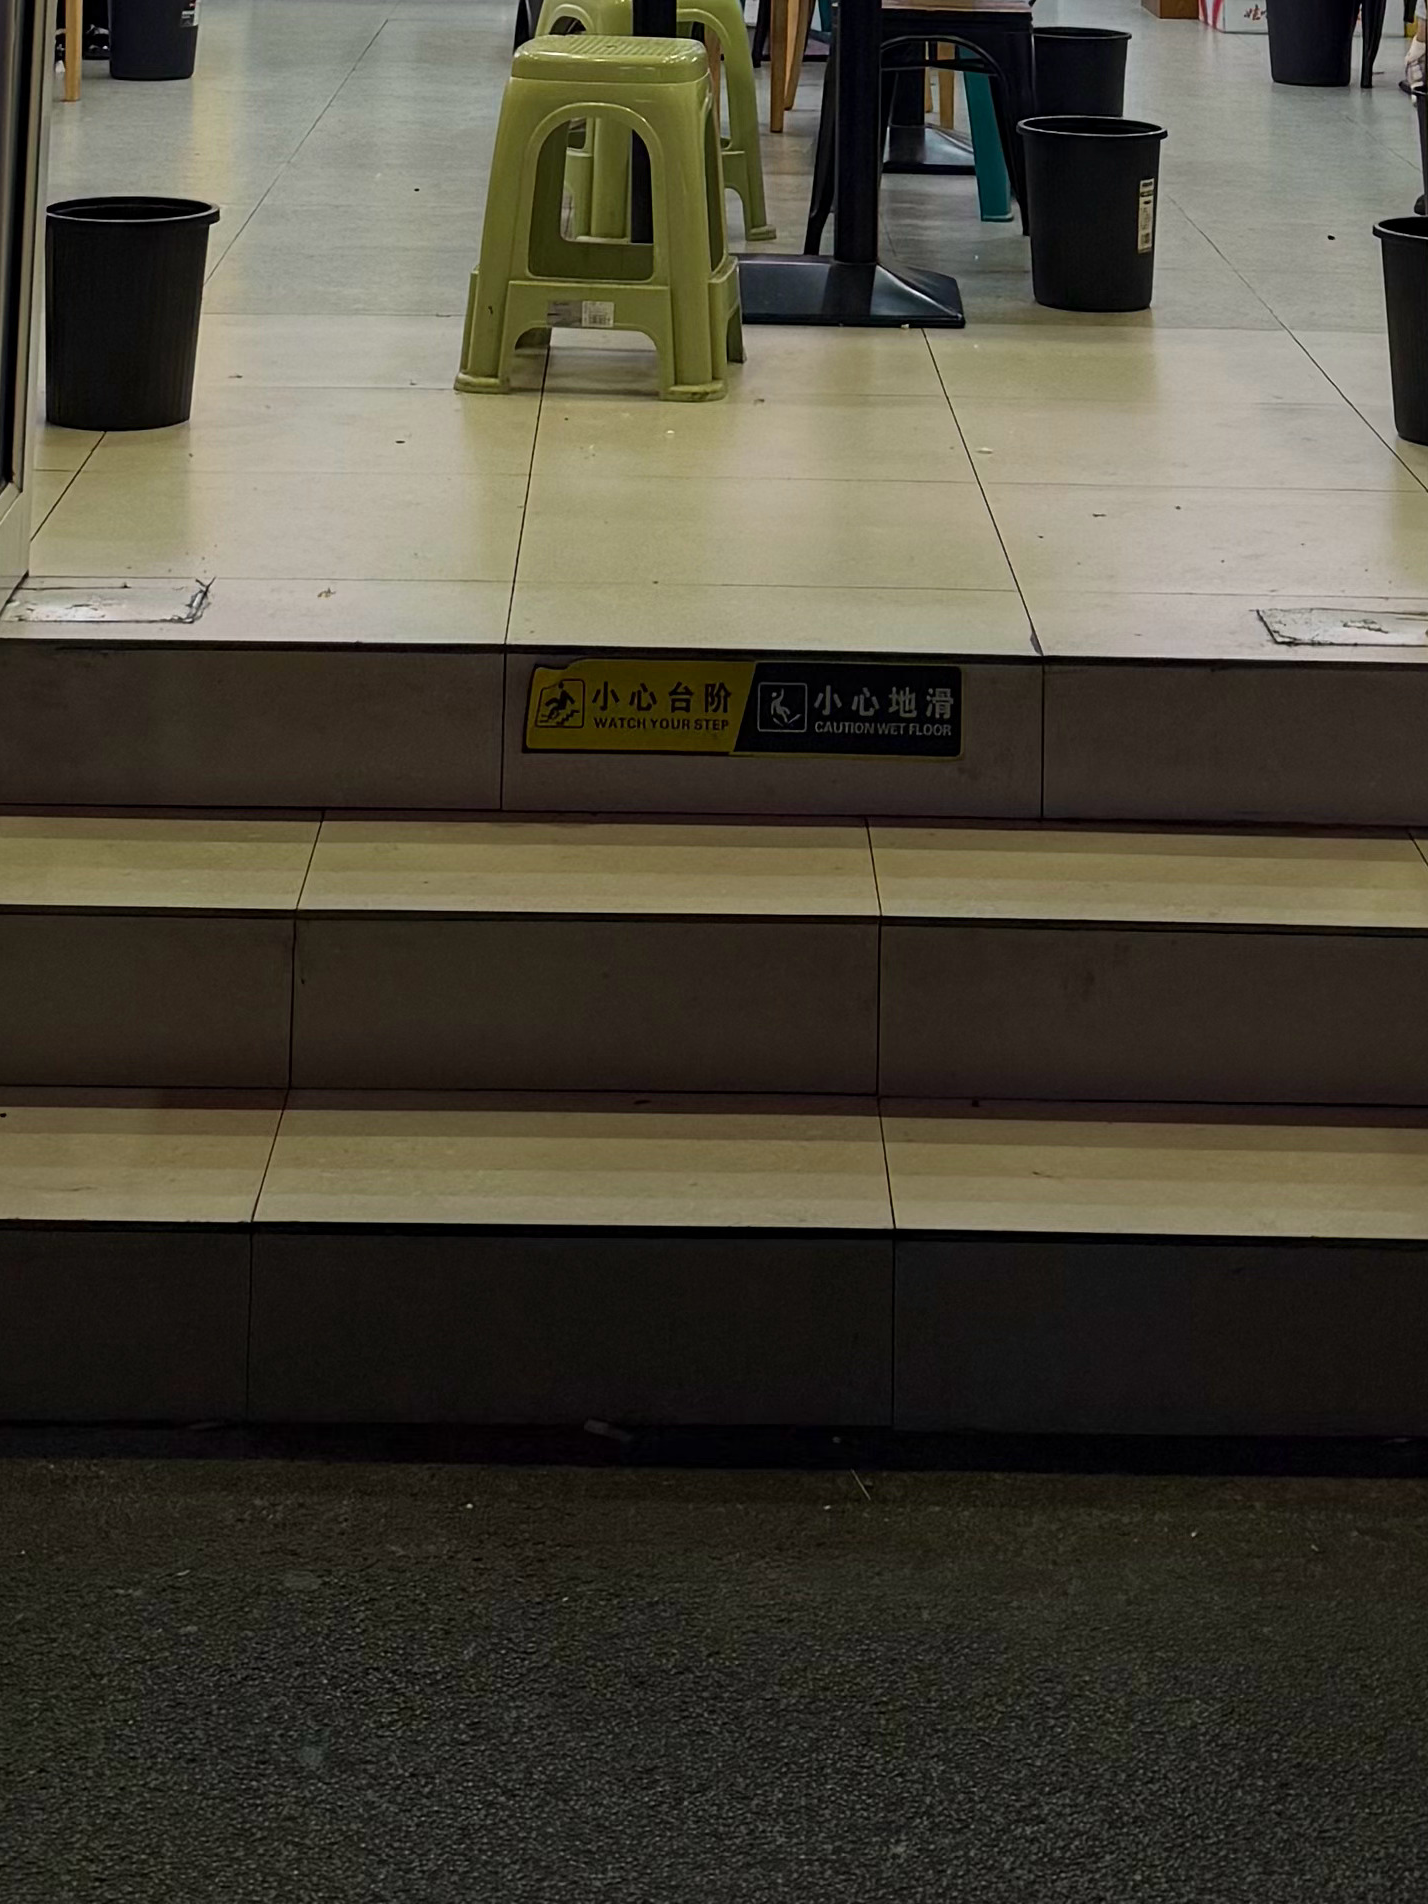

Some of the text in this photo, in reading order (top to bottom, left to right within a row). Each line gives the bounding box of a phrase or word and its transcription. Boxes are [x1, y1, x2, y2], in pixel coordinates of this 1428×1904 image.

[590, 681, 733, 715] 小心台阶
[813, 685, 955, 720] 小心地滑
[593, 716, 730, 732] WATCH YOUR STEP
[814, 720, 952, 737] CAUTION WET FLOOR
